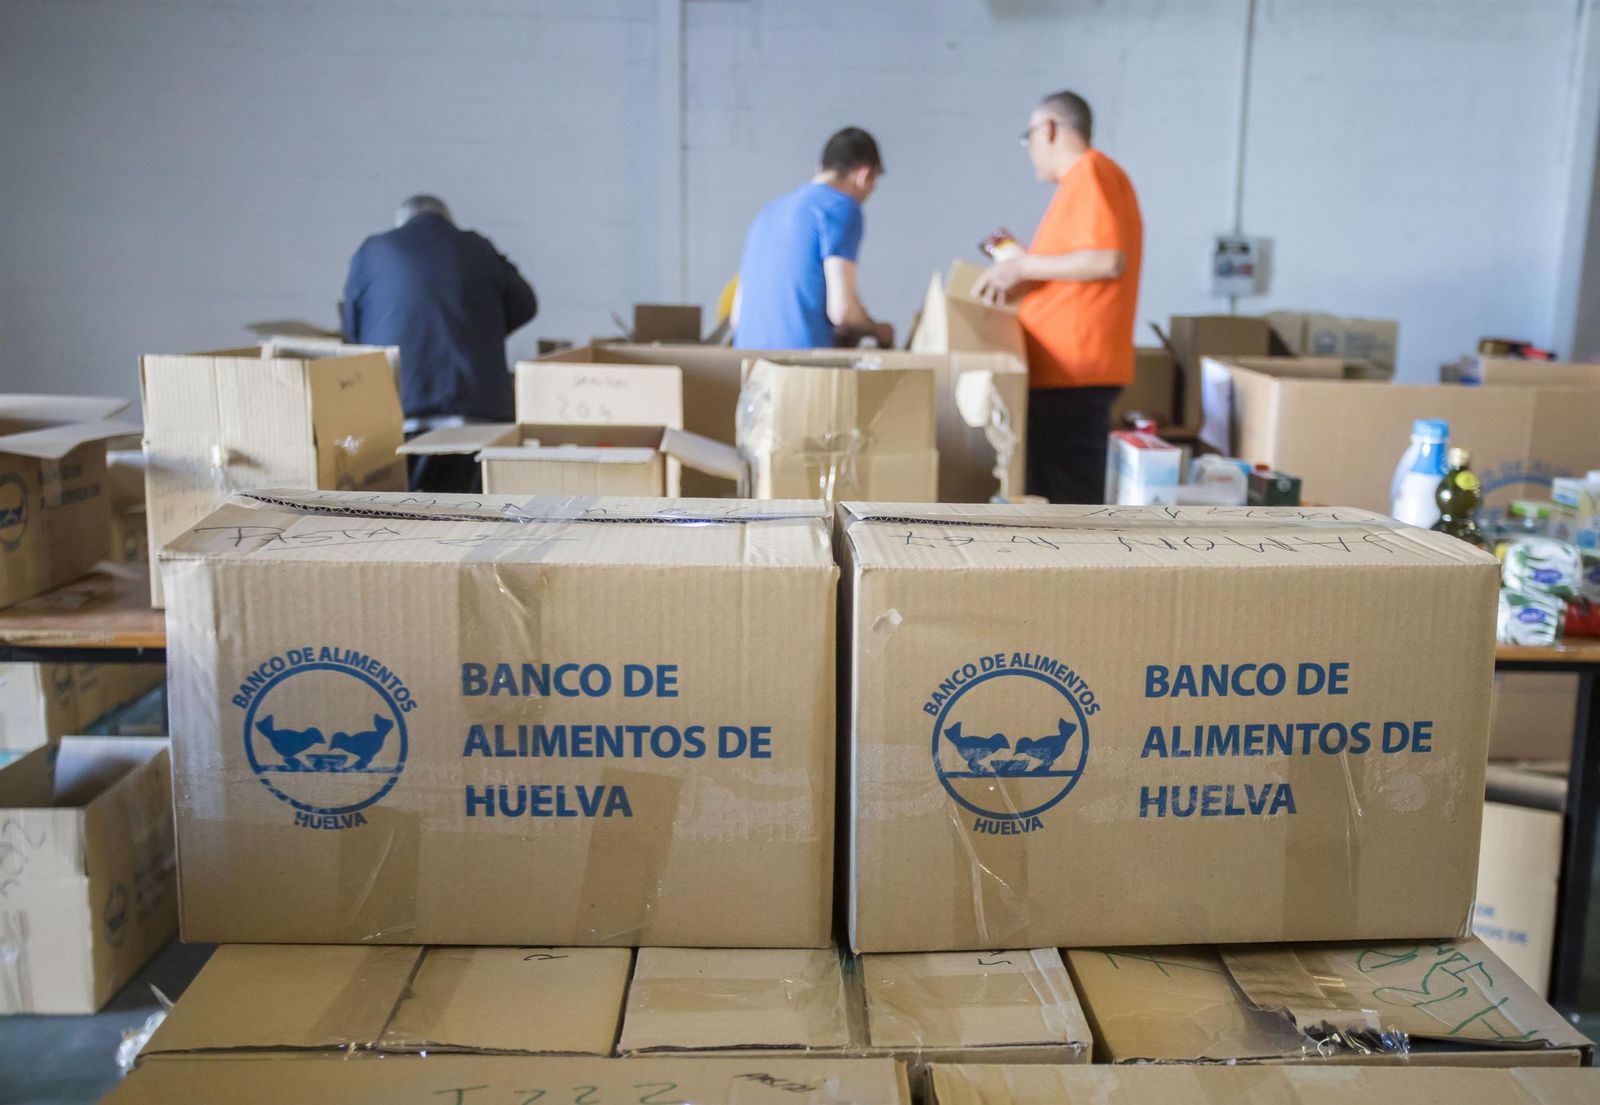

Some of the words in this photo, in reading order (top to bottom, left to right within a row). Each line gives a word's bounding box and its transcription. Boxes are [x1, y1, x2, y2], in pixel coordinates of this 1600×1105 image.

[193, 525, 401, 548] PASTA
[1114, 531, 1395, 554] JAMON
[231, 655, 286, 710] BANCO
[286, 646, 315, 666] DE
[318, 646, 418, 713] ALIMENTOS
[461, 663, 612, 698] BANCO
[623, 664, 679, 698] DE
[923, 662, 978, 717] BANCO
[979, 653, 1007, 673] DE
[1009, 652, 1101, 716] ALIMENTOS
[1144, 663, 1286, 698] BANCO
[1297, 662, 1350, 696] DE
[462, 724, 707, 759] ALIMENTOS
[717, 726, 772, 759] DE
[1140, 722, 1371, 758] ALIMENTOS
[1382, 720, 1434, 753] DE
[465, 785, 633, 818] HUELVA
[1139, 783, 1297, 818] HUELVA
[293, 810, 368, 830] HUELVA
[973, 815, 1045, 836] HUELVA
